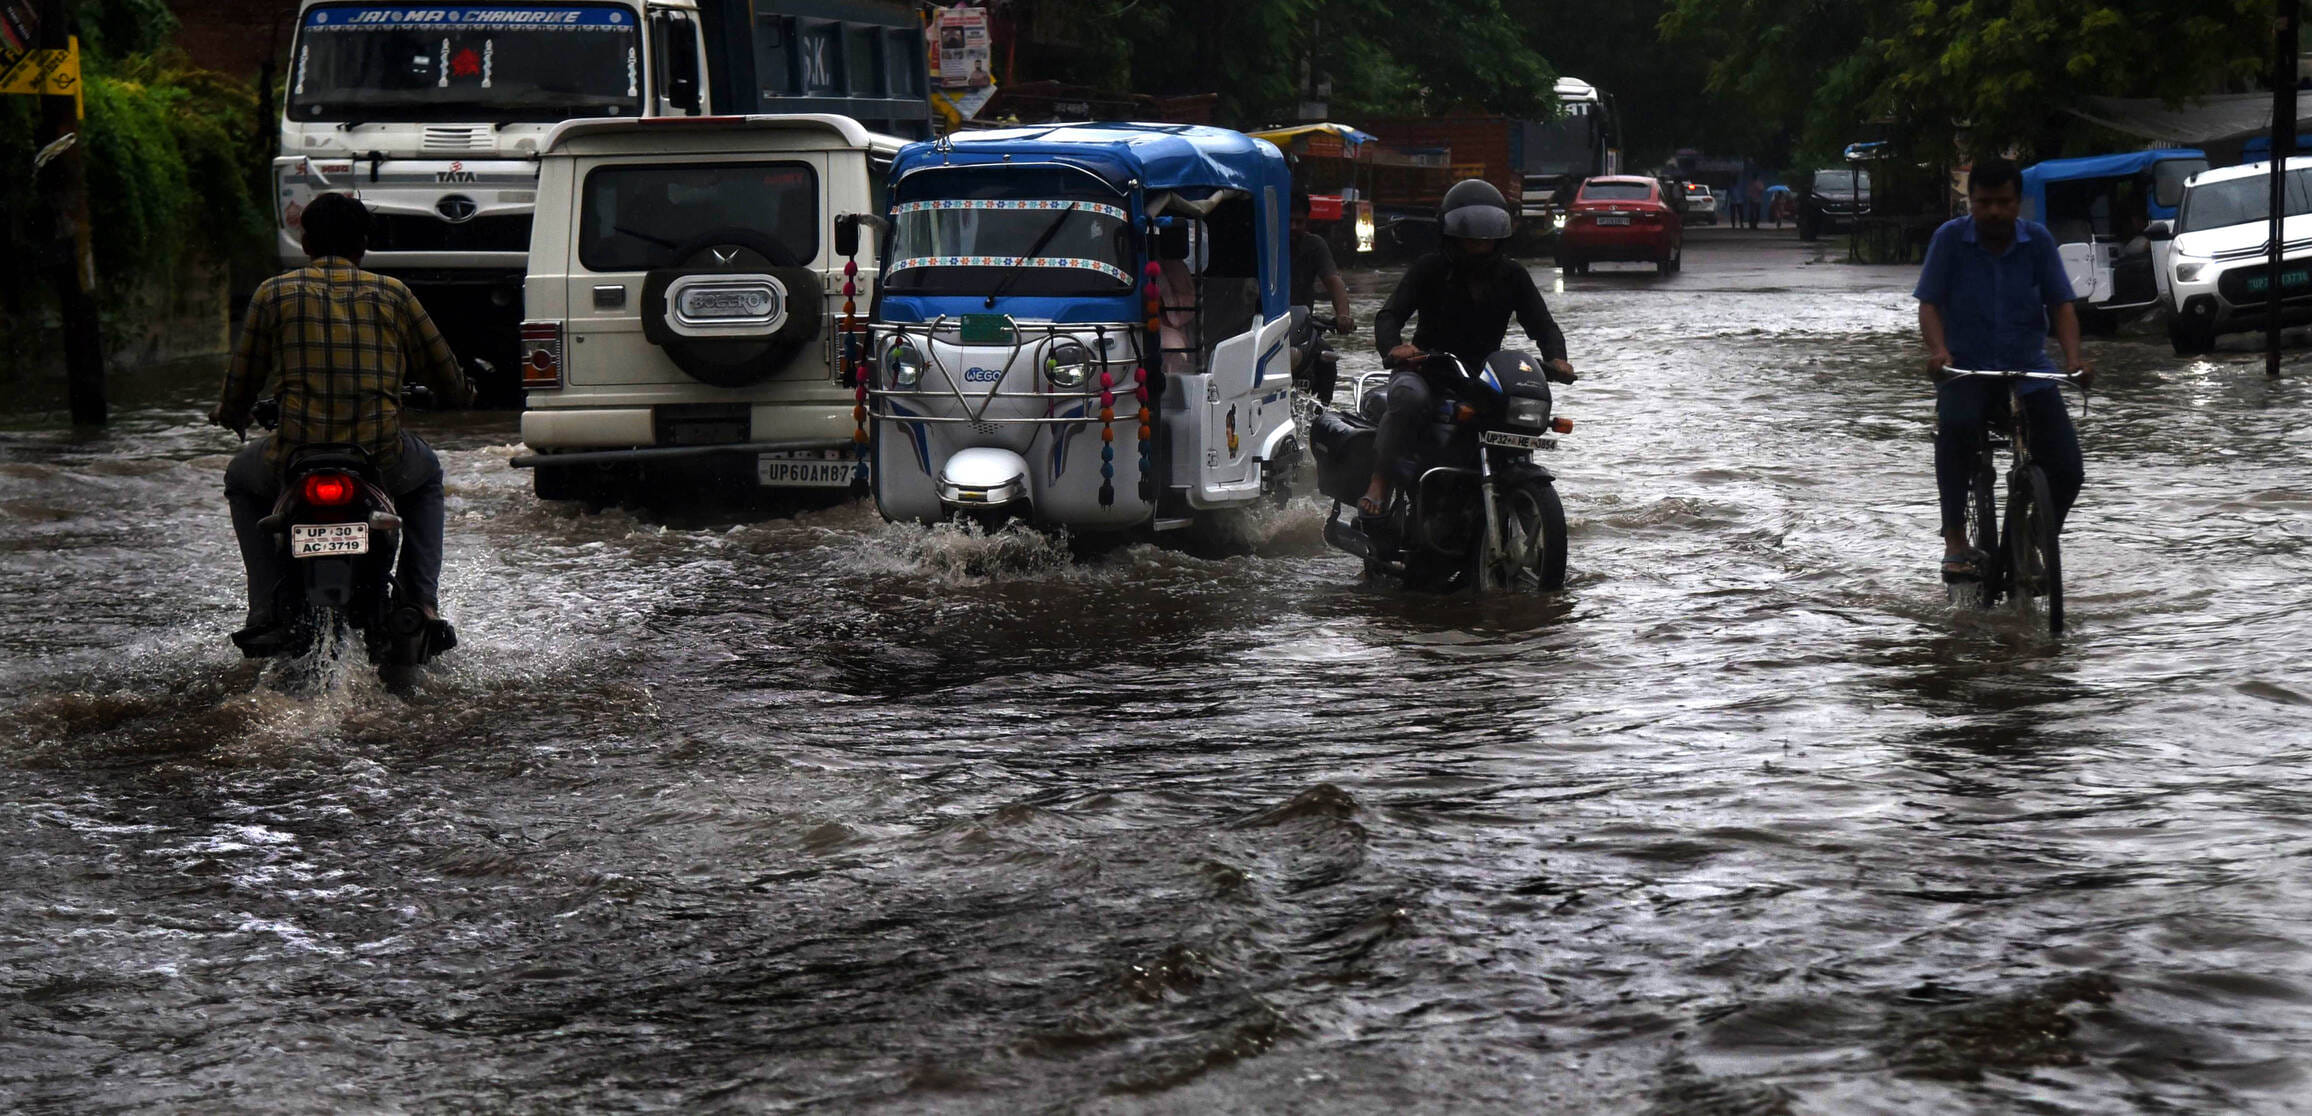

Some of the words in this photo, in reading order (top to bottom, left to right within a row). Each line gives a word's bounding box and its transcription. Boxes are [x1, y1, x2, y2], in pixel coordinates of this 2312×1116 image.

[349, 11, 392, 23] JAI
[403, 10, 445, 22] MA
[462, 10, 582, 23] CHANDRIKE
[436, 171, 476, 182] TATA
[966, 369, 1002, 381] WEGO
[307, 528, 327, 538] UP
[335, 527, 352, 537] 30
[302, 543, 321, 553] AC
[328, 541, 360, 551] 3719
